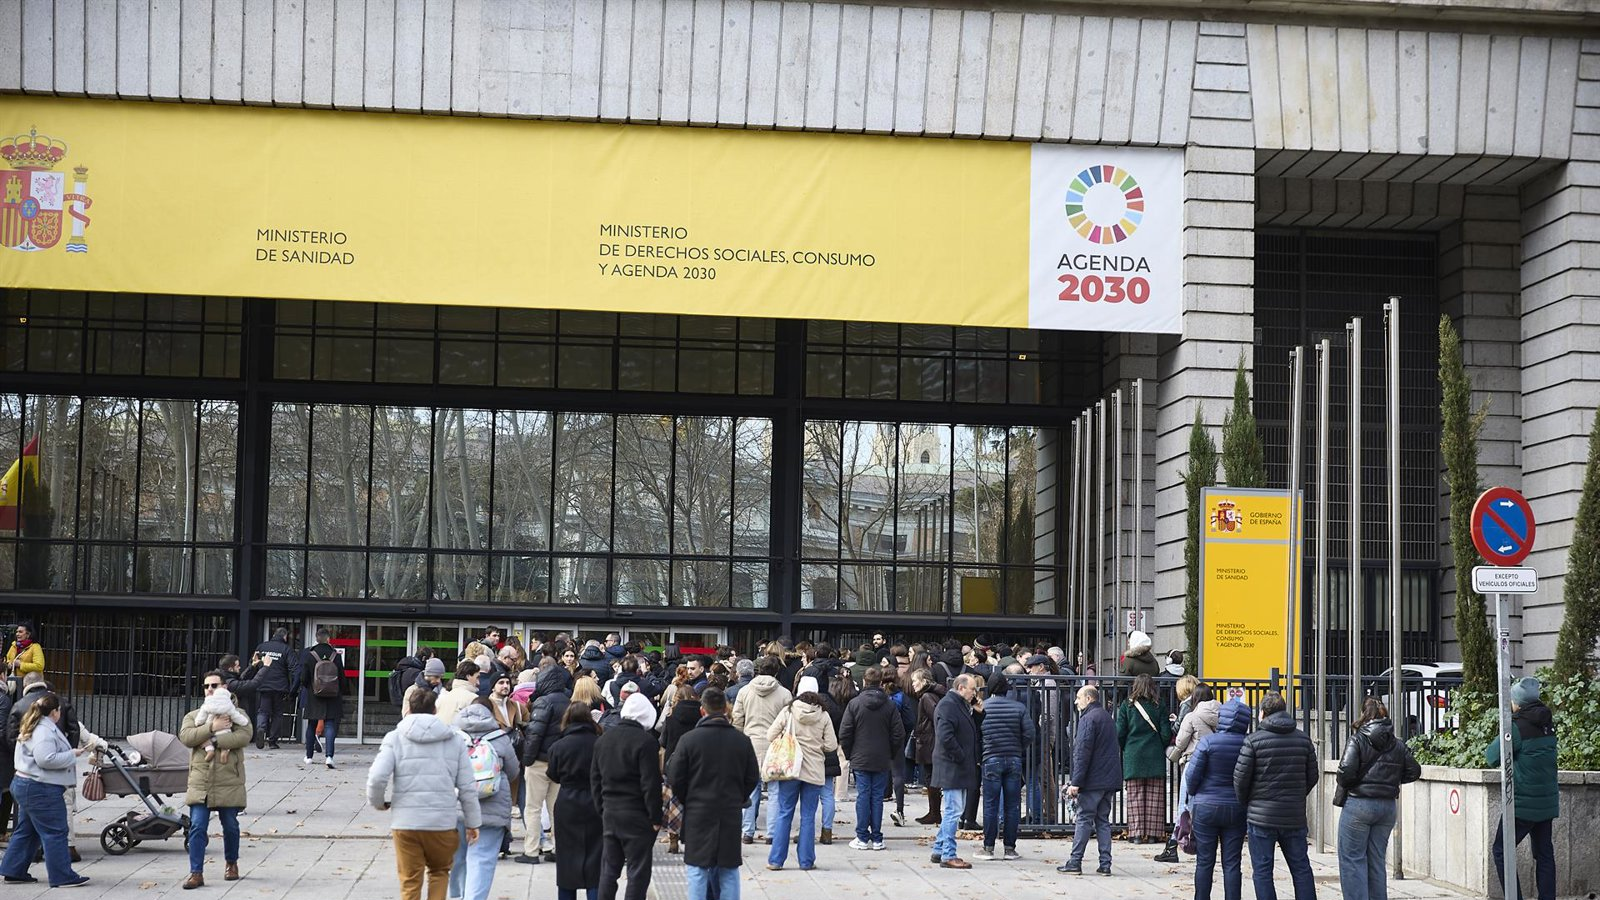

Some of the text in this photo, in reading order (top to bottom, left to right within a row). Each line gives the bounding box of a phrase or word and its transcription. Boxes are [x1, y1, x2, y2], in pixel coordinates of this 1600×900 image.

[256, 228, 348, 244] MINISTERIO
[600, 224, 688, 240] MINISTERIO
[256, 248, 355, 265] DE SANIDAD
[599, 243, 876, 267] DE DERECHOS SOCIALES, CONSUMO
[1057, 253, 1151, 272] AGENDA
[598, 263, 717, 281] Y AGENDA 2030
[1057, 273, 1151, 305] 2030
[1249, 511, 1283, 519] GOBIERNO
